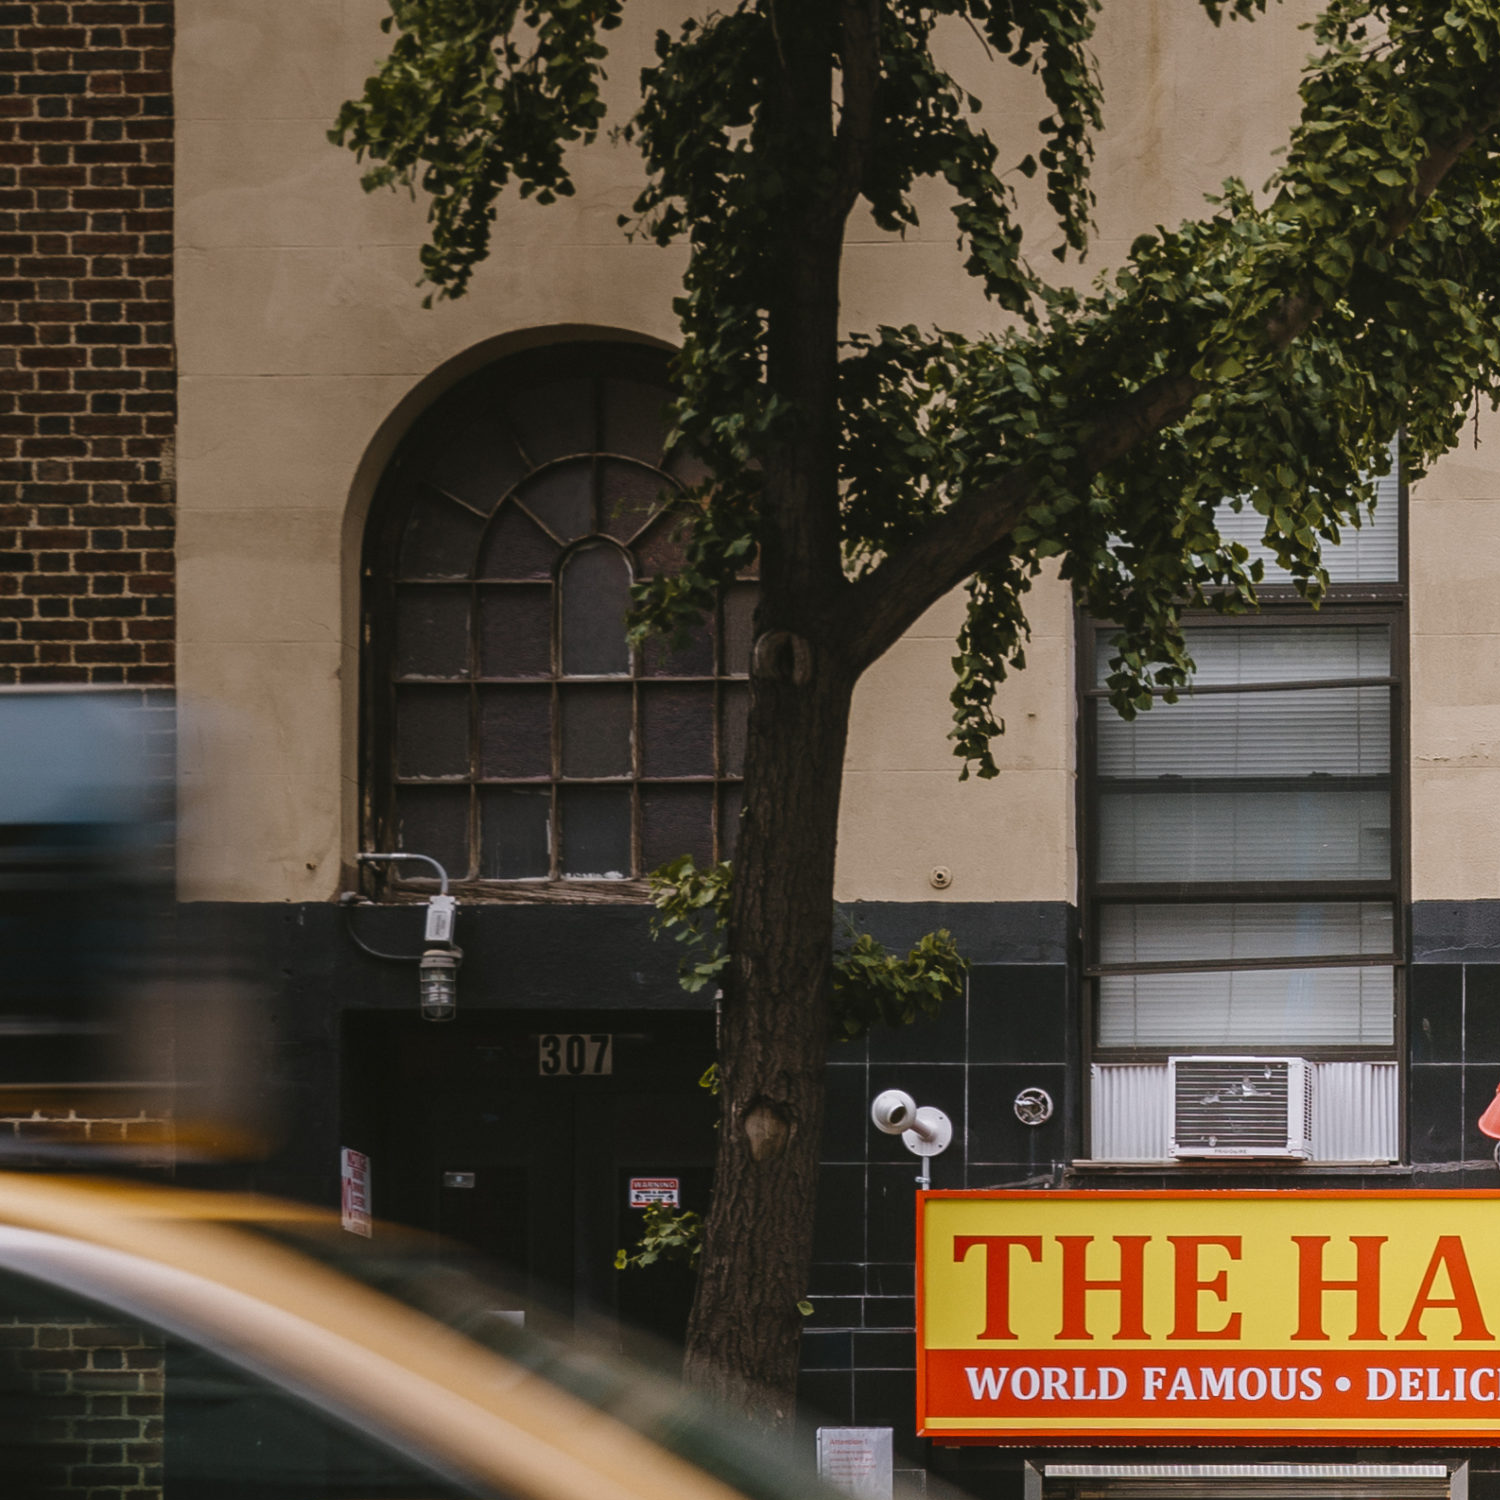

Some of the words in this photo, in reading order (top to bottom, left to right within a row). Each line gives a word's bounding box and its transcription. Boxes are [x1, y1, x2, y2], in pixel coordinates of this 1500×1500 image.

[541, 1035, 610, 1075] 307
[953, 1234, 1243, 1342] THE
[964, 1366, 1127, 1401] WORLD
[1142, 1366, 1323, 1402] FAMOUS
